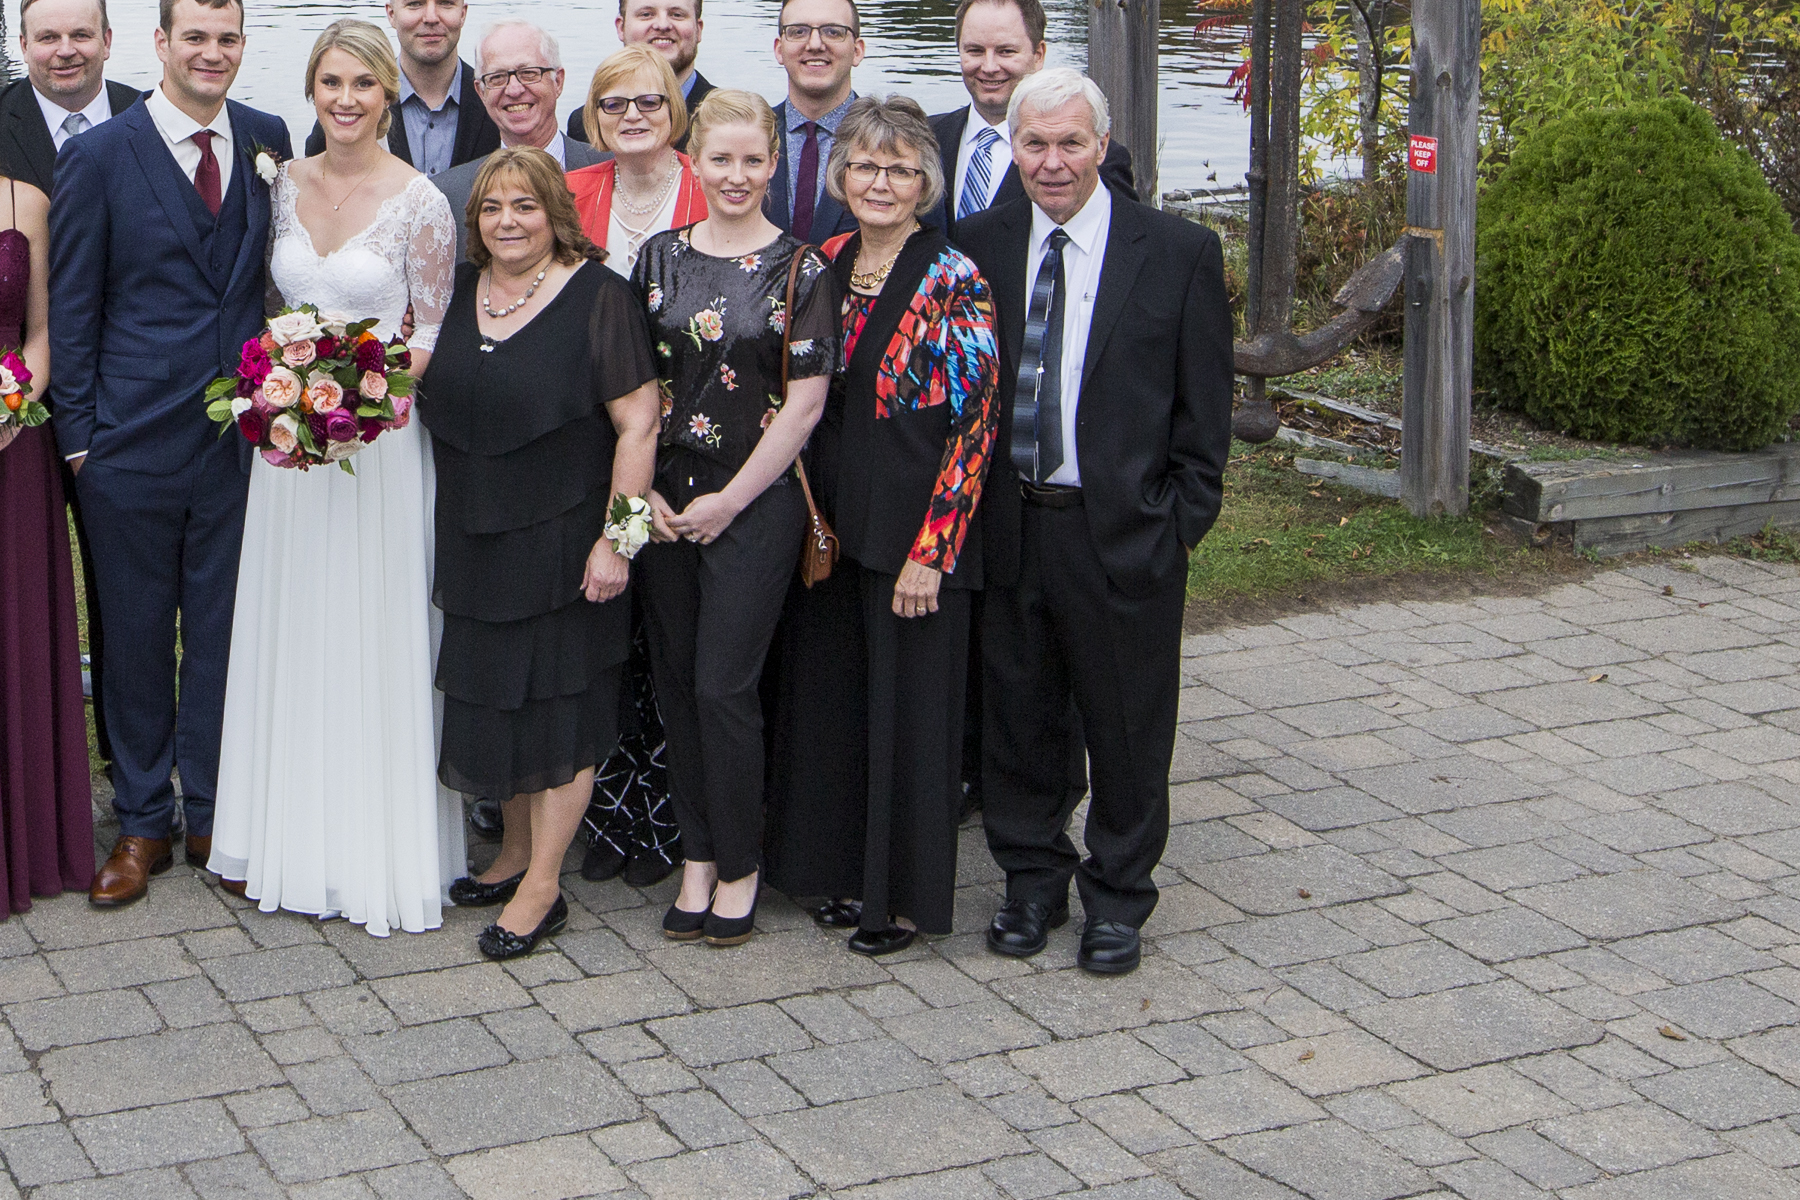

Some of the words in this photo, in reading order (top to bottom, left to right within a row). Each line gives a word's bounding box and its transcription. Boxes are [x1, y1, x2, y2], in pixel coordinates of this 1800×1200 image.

[1411, 140, 1436, 150] PLEASE
[1414, 150, 1432, 159] KEEP
[1416, 159, 1430, 167] OFF
